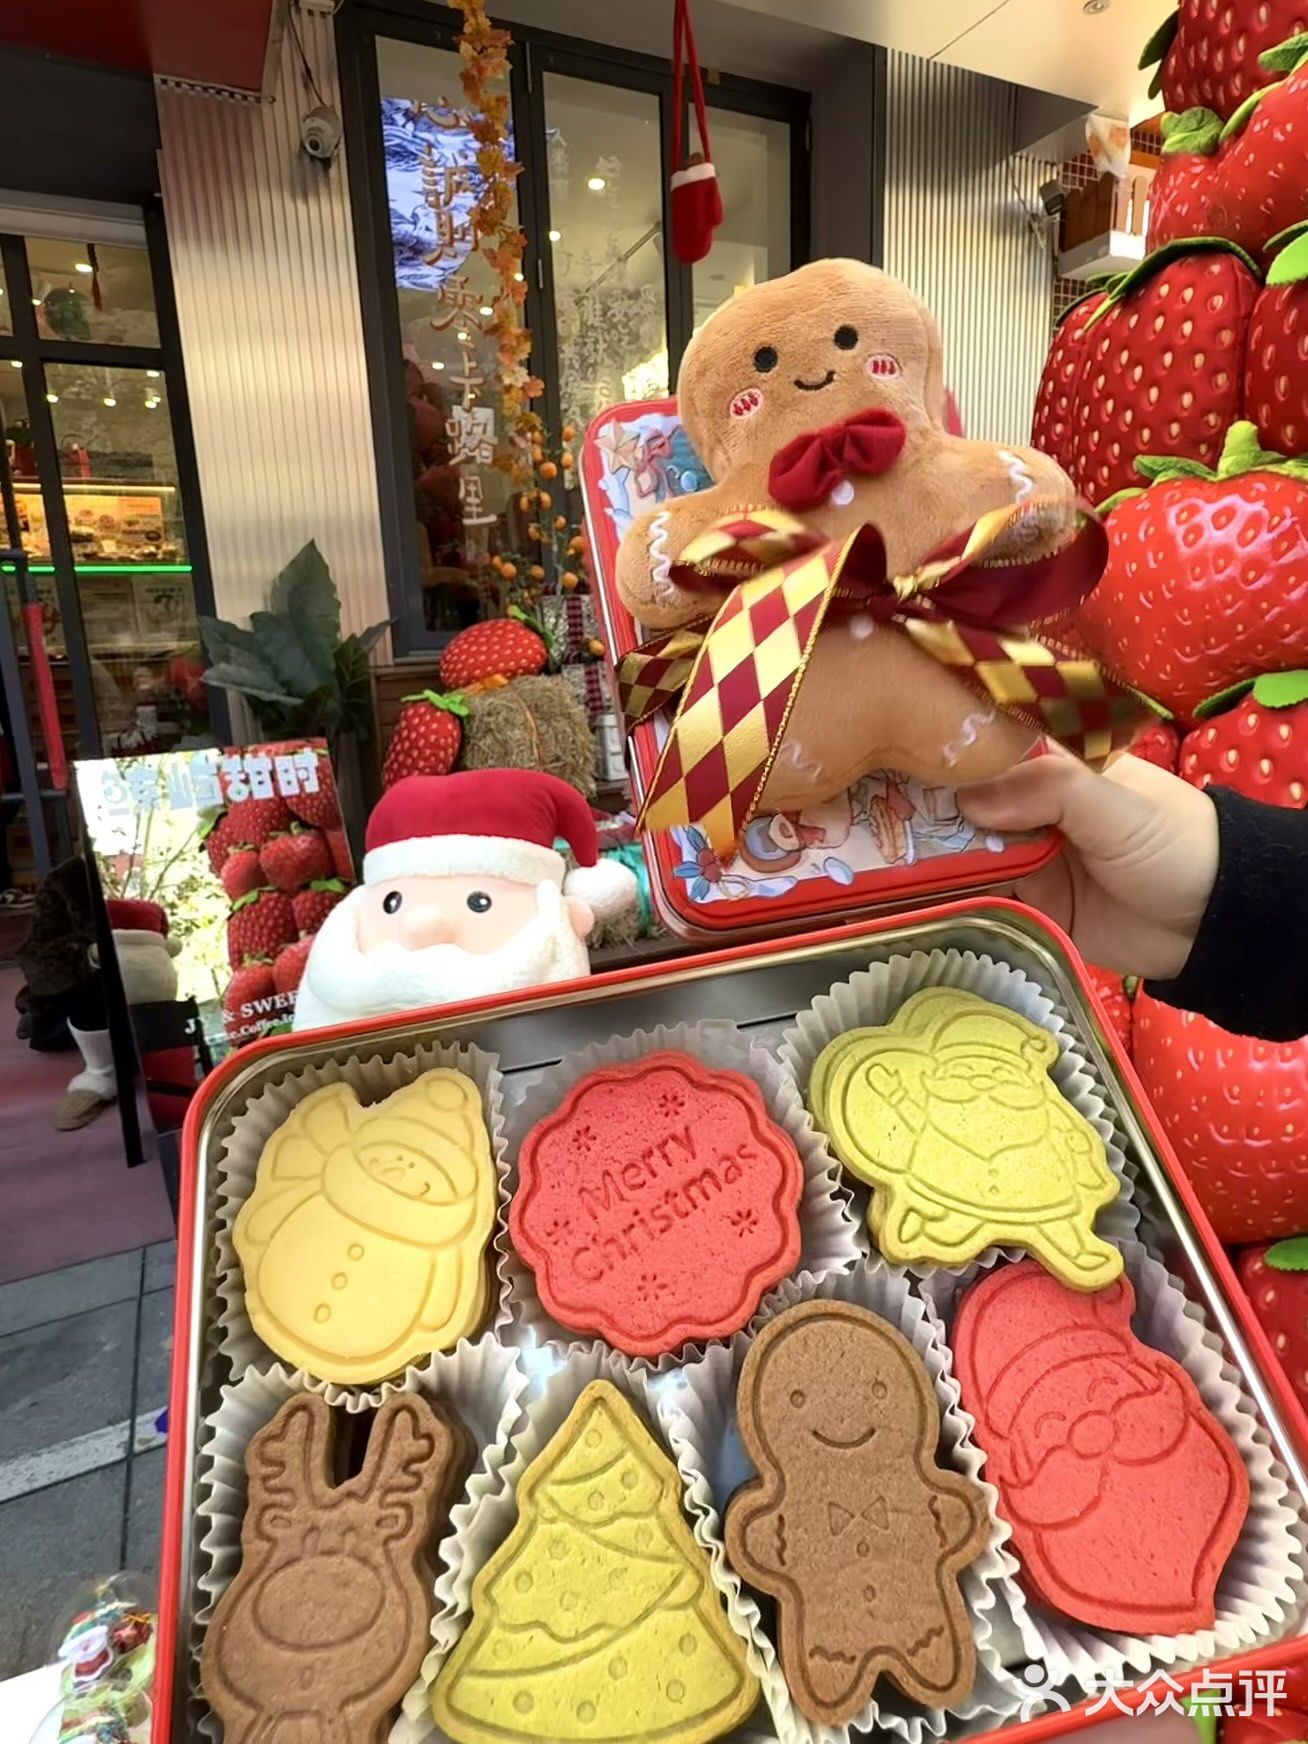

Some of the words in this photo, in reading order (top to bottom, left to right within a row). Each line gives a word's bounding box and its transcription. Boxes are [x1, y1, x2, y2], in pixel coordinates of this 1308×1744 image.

[240, 990, 299, 1018] SWEE
[571, 1143, 758, 1281] Christmas
[578, 1125, 697, 1221] Merry
